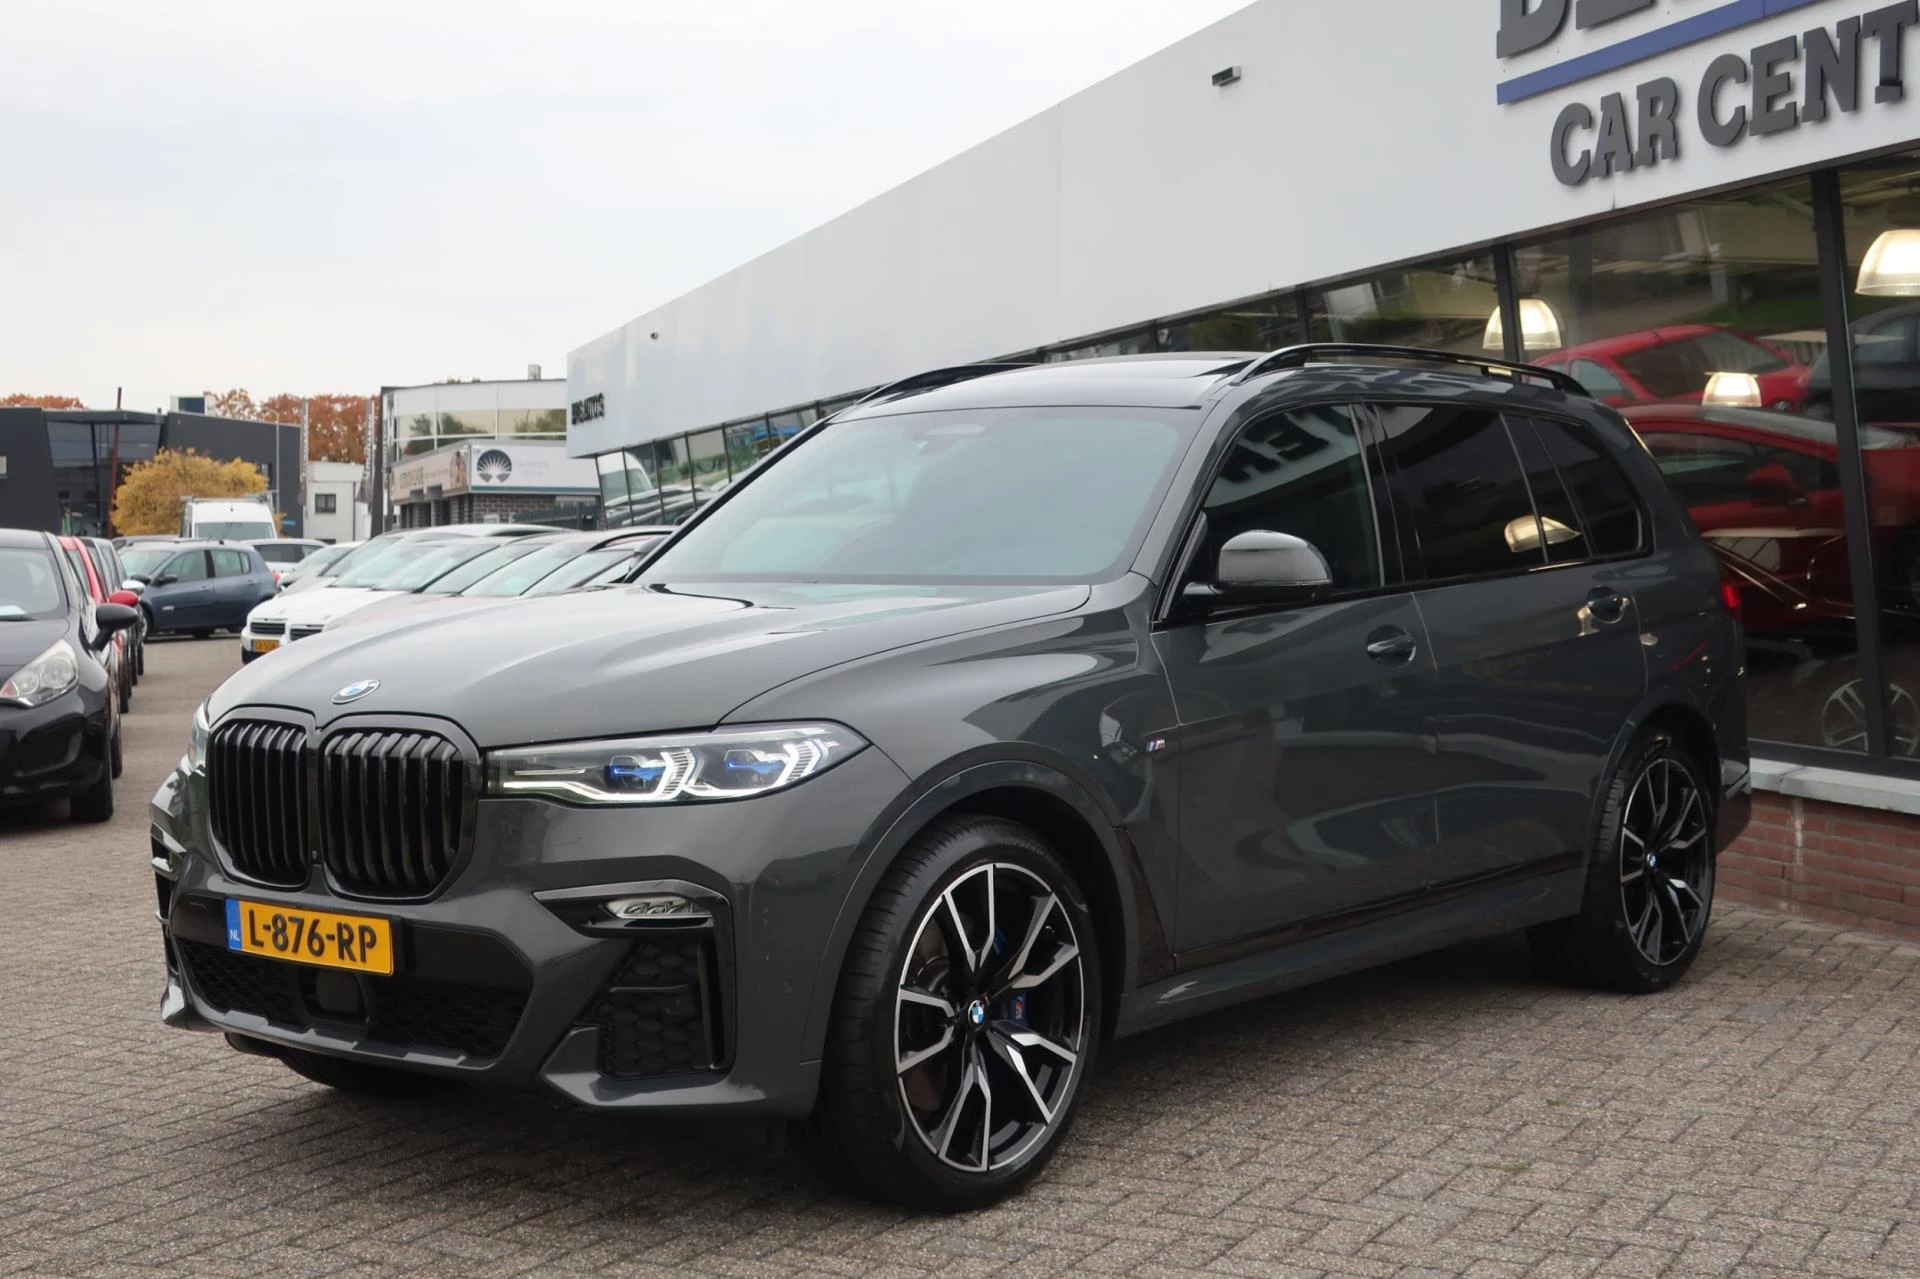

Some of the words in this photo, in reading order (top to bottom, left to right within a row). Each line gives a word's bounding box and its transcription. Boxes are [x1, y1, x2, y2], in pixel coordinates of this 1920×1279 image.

[1550, 77, 1678, 186] CAR
[1698, 0, 1918, 146] CENT
[229, 929, 241, 942] NL
[248, 909, 377, 963] L-876-RP
